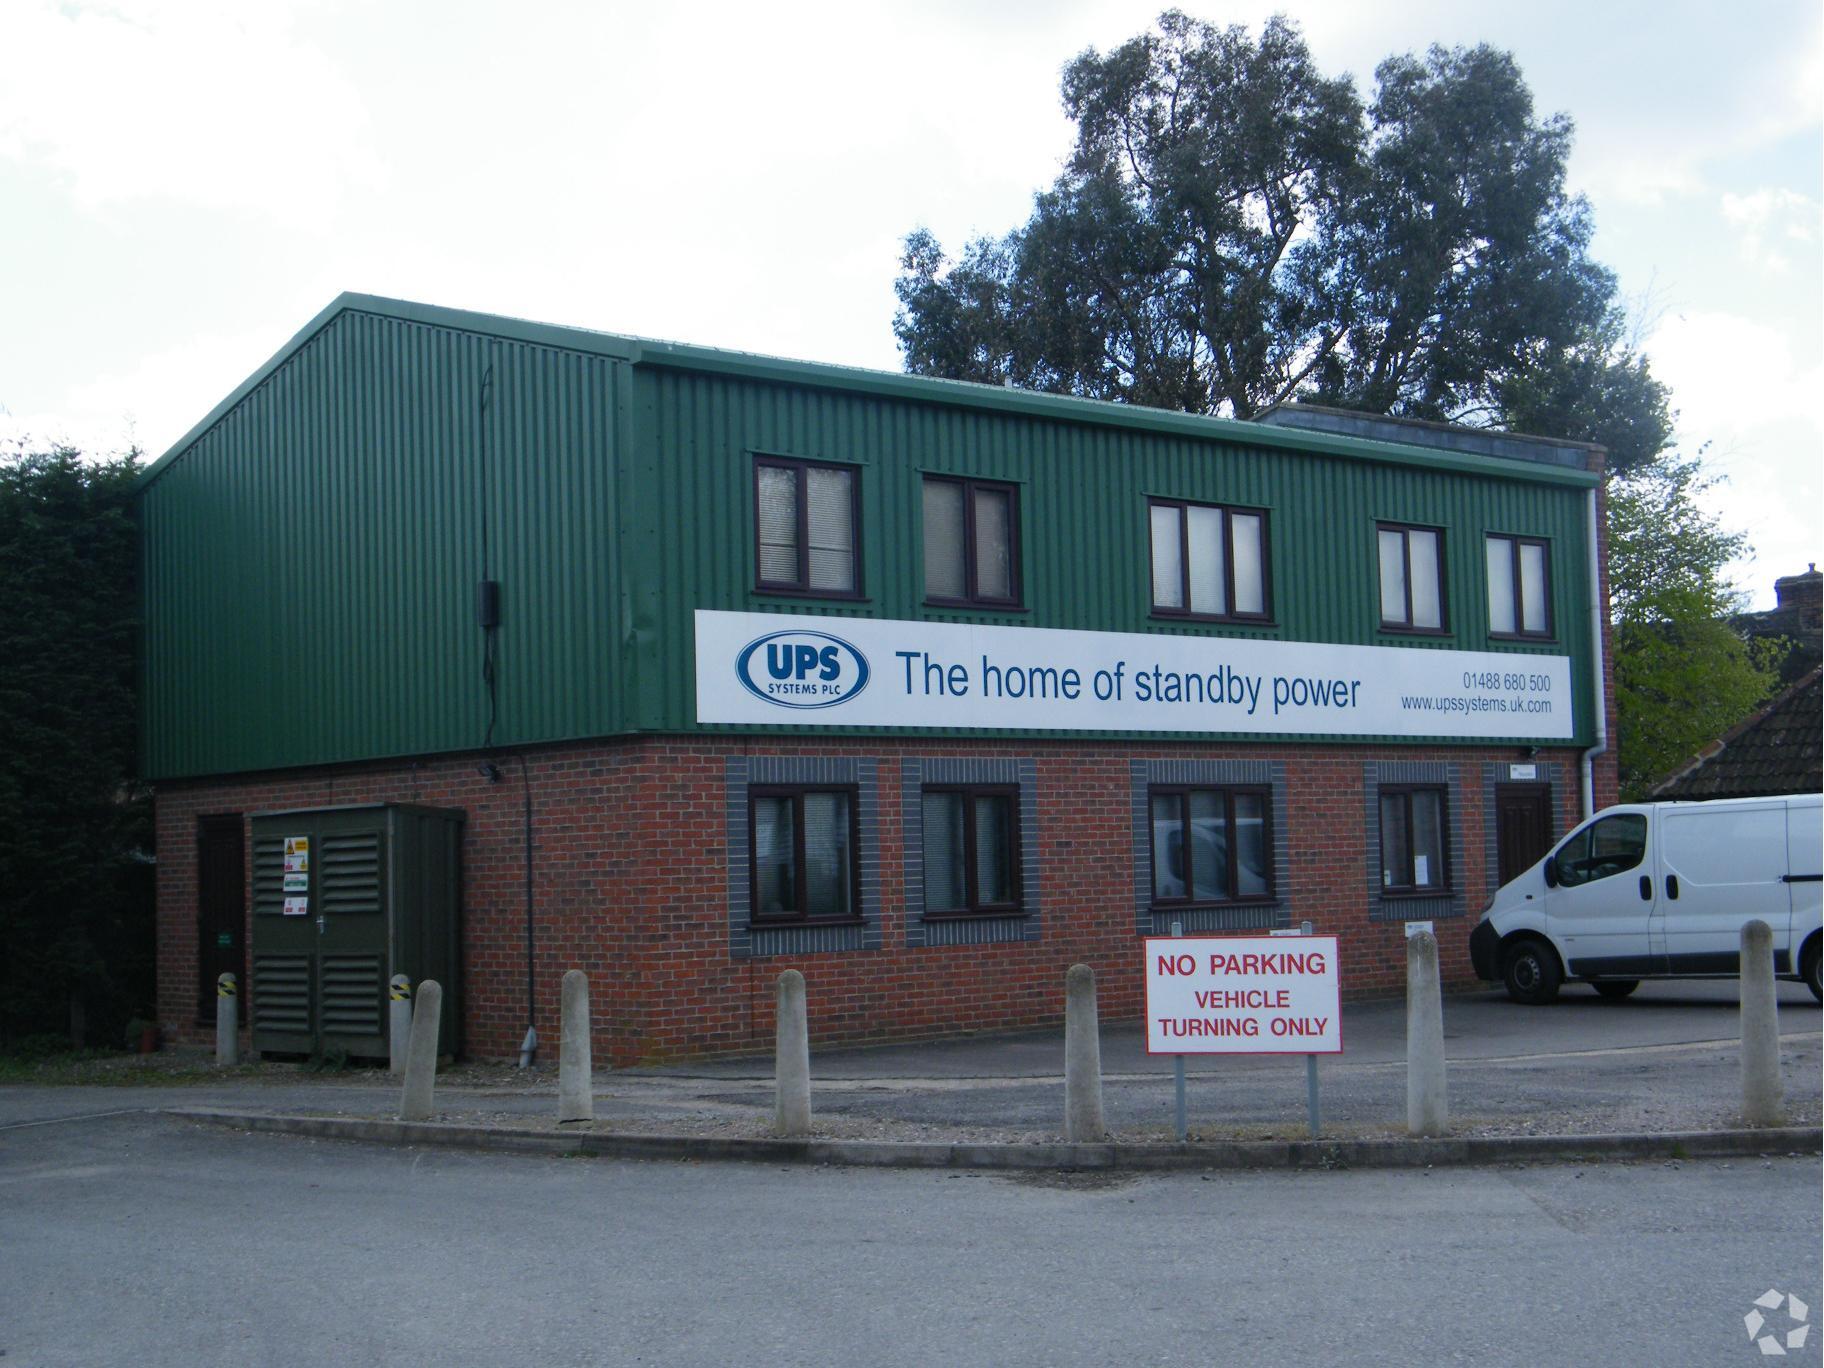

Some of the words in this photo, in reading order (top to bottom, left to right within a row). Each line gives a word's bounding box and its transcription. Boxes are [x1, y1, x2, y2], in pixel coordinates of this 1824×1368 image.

[766, 644, 841, 681] UPS
[768, 683, 818, 696] SYSTEMS
[822, 685, 841, 696] PLC
[895, 651, 969, 697] The
[982, 655, 1081, 700] home
[1094, 660, 1126, 701] of
[1135, 664, 1262, 715] standby
[1273, 676, 1361, 715] power
[1463, 671, 1501, 690] 01488
[1504, 673, 1526, 691] 680
[1529, 675, 1551, 692] 500
[1401, 695, 1552, 716] www.upssystems.uk.com
[1158, 954, 1196, 976] NO
[1210, 953, 1326, 975] PARKING
[1194, 990, 1290, 1009] VEHICLE
[1158, 1018, 1259, 1037] TURNING
[1270, 1017, 1328, 1036] ONLY
